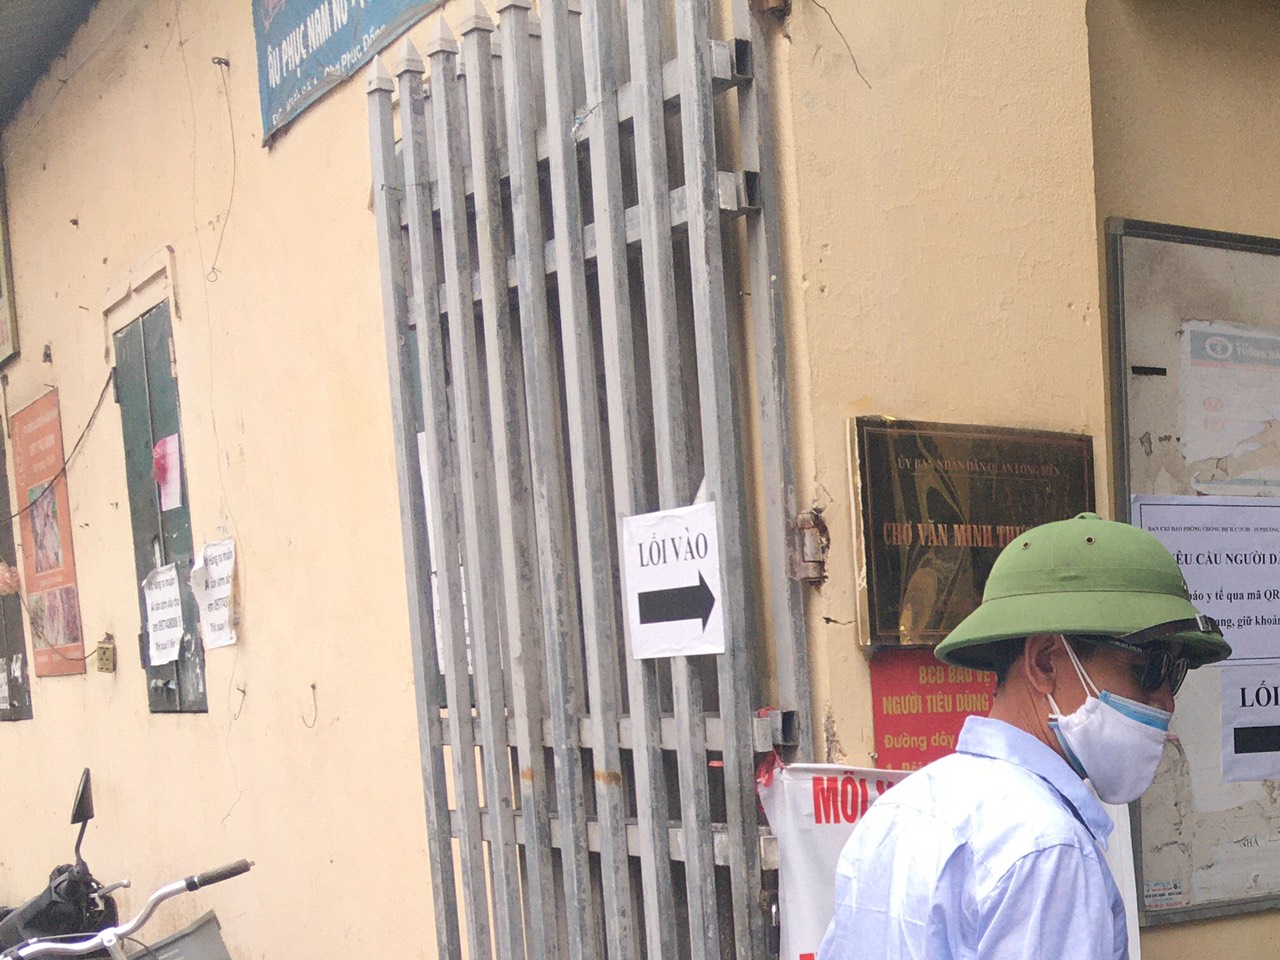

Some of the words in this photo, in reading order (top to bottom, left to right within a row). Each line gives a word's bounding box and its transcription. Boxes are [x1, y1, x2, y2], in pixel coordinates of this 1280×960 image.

[306, 4, 332, 53] NAM
[917, 519, 948, 546] VĂN
[953, 523, 993, 548] MINH
[638, 532, 667, 568] LỐI
[670, 527, 709, 562] VÀO
[1174, 550, 1193, 565] ÊU
[1226, 549, 1266, 565] NGƯỜI
[1207, 593, 1212, 603] y
[1215, 587, 1224, 600] tế
[1226, 592, 1244, 603] qua
[1247, 590, 1261, 600] mã
[1264, 589, 1280, 602] QR
[1237, 615, 1253, 629] giữ
[883, 691, 922, 715] NGƯỜI
[926, 691, 952, 713] TIÊU
[956, 690, 990, 712] DÙNG
[1240, 680, 1280, 707] LỐI
[884, 732, 928, 751] Đường
[931, 731, 956, 749] dây
